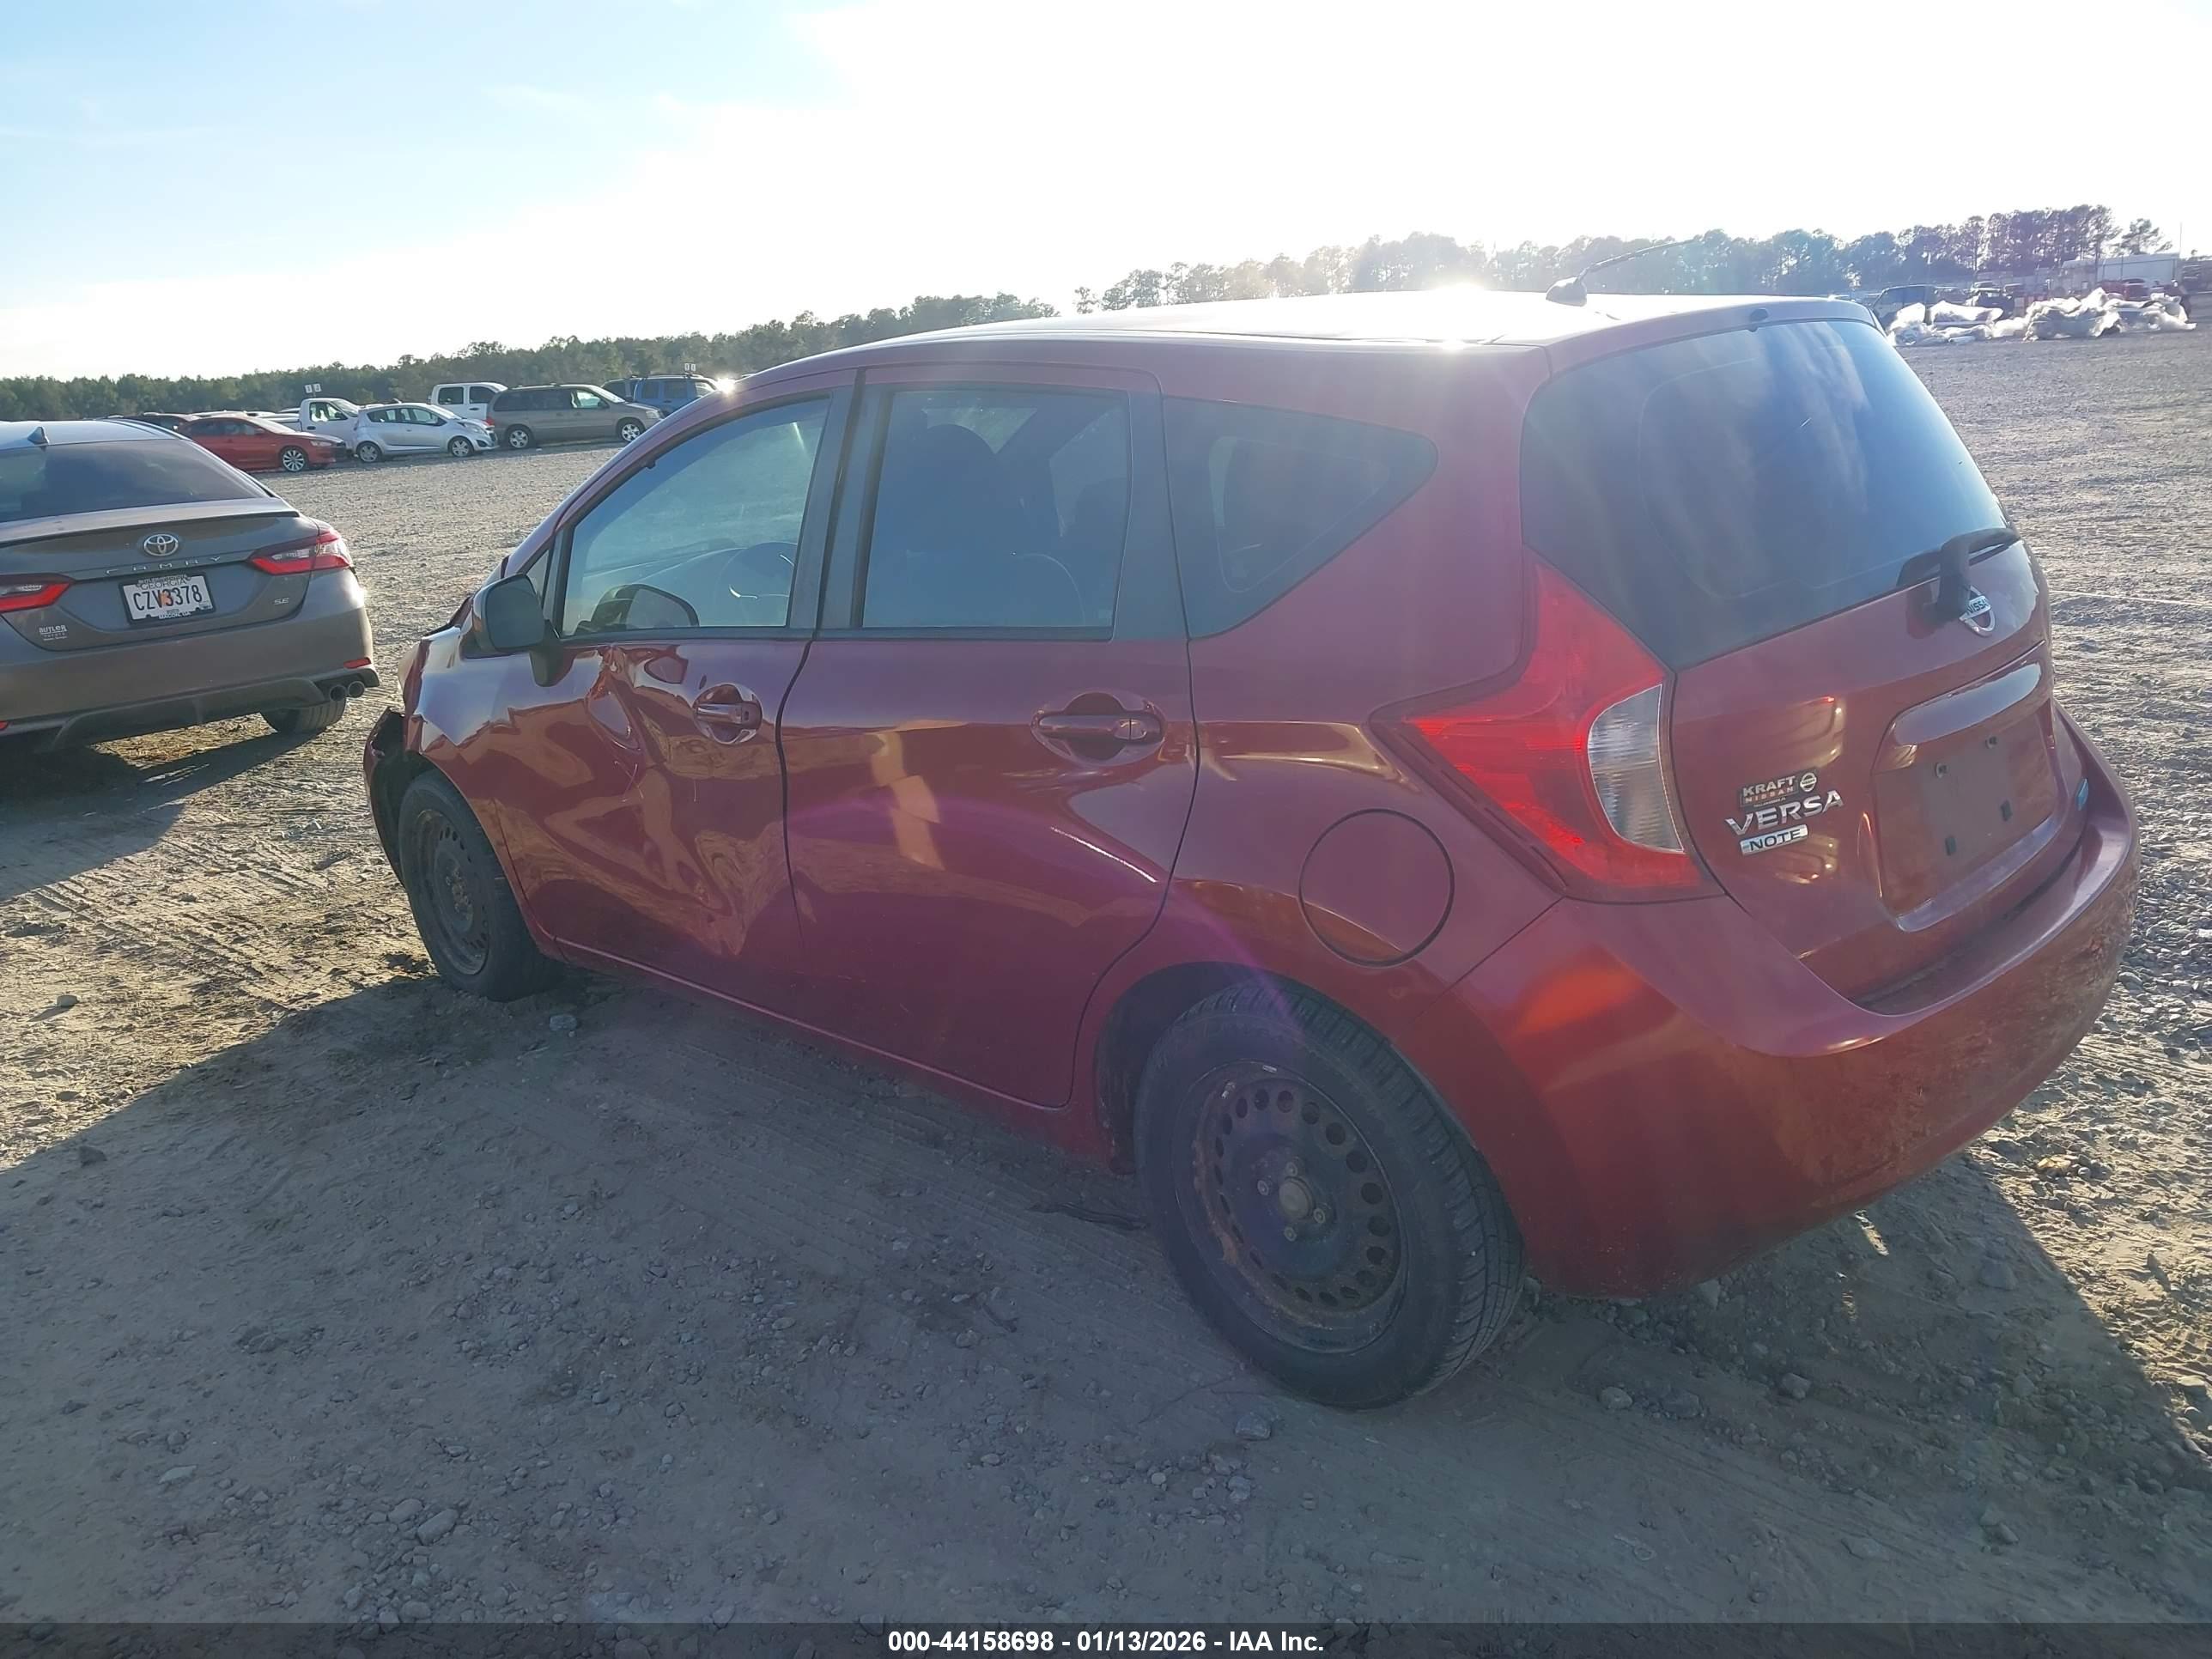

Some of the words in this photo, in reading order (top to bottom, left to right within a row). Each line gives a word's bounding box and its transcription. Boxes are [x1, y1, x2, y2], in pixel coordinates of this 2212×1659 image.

[133, 585, 203, 611] CZV3378
[1743, 775, 1796, 797] KRAFT
[1745, 786, 1794, 803] NISSAN
[1724, 790, 1844, 836] VERSA
[1749, 829, 1801, 851] NOTE
